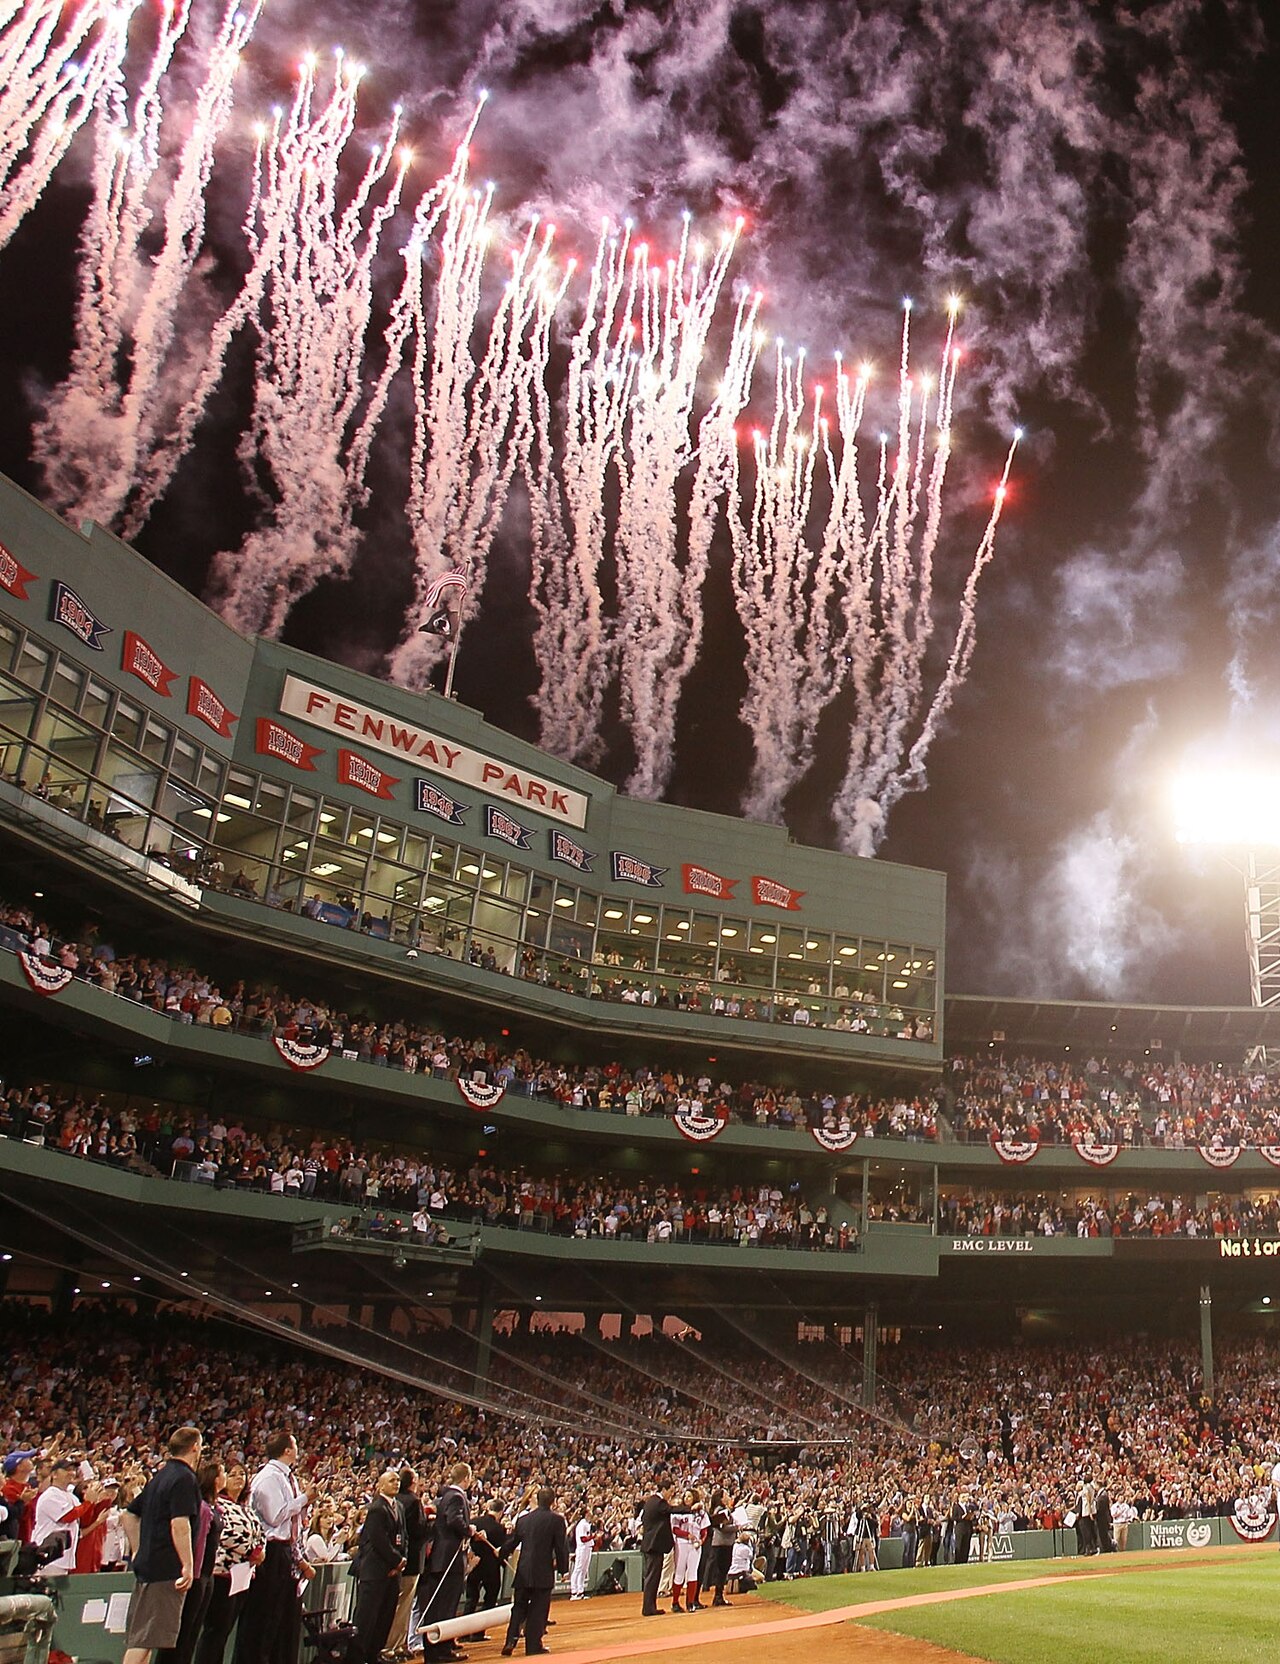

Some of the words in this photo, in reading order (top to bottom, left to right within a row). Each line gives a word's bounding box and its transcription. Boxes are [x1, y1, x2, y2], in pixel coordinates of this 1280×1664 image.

[268, 730, 303, 760] 1916
[306, 691, 463, 769] FENWAY
[482, 762, 569, 814] PARK
[349, 760, 381, 788] 1918
[491, 814, 522, 840] 1967
[952, 1240, 985, 1251] EMC
[988, 1240, 1033, 1252] LEVEL
[1150, 1523, 1185, 1536] Ninety
[1150, 1534, 1184, 1548] Nine
